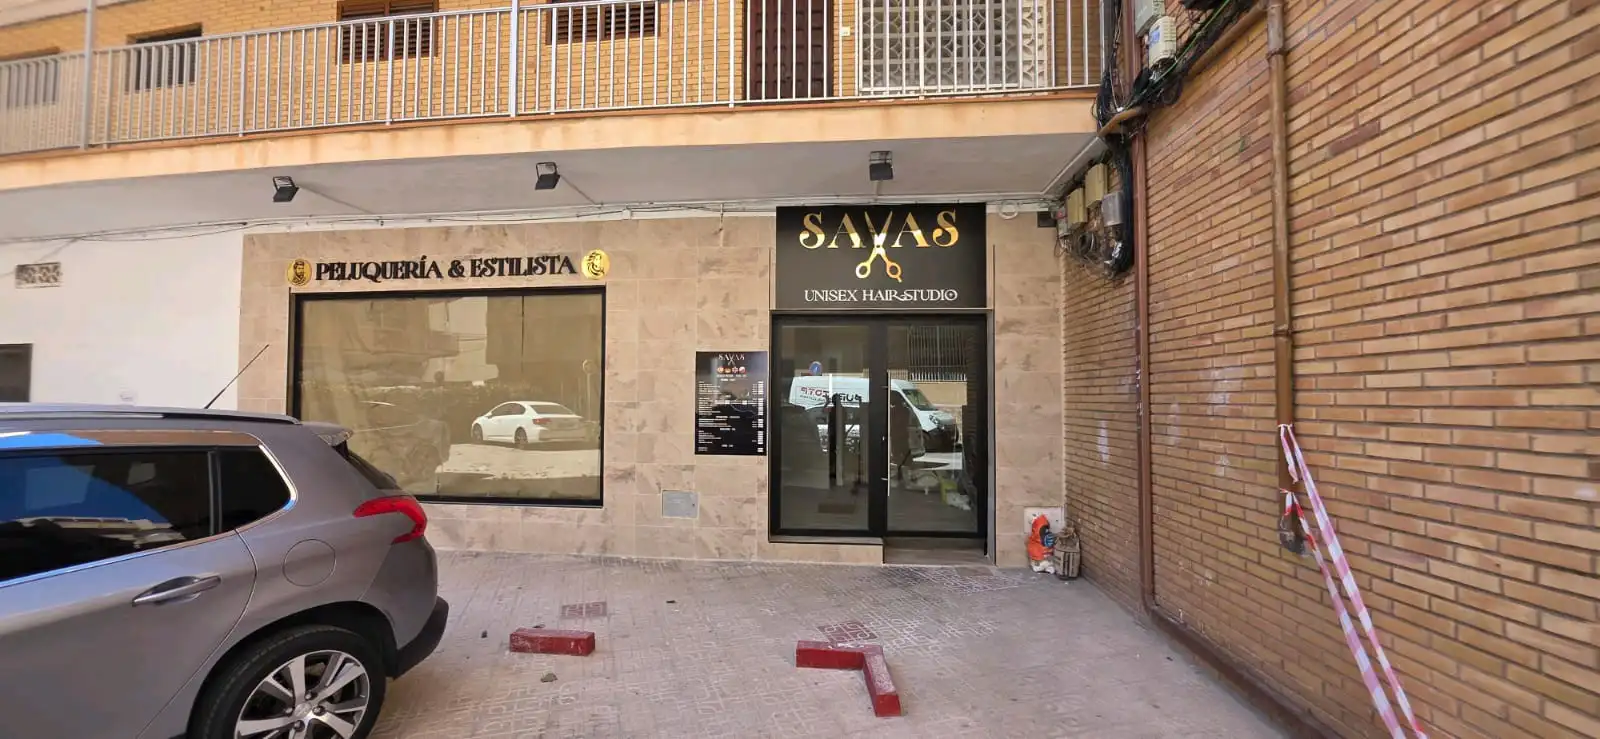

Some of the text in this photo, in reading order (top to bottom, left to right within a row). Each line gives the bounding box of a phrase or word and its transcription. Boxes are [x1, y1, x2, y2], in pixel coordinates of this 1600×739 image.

[799, 210, 959, 249] SAVAS
[315, 254, 577, 283] PELUQUERÍA & ESTILISTA
[804, 288, 958, 302] UNISEX HAIR STUDIO
